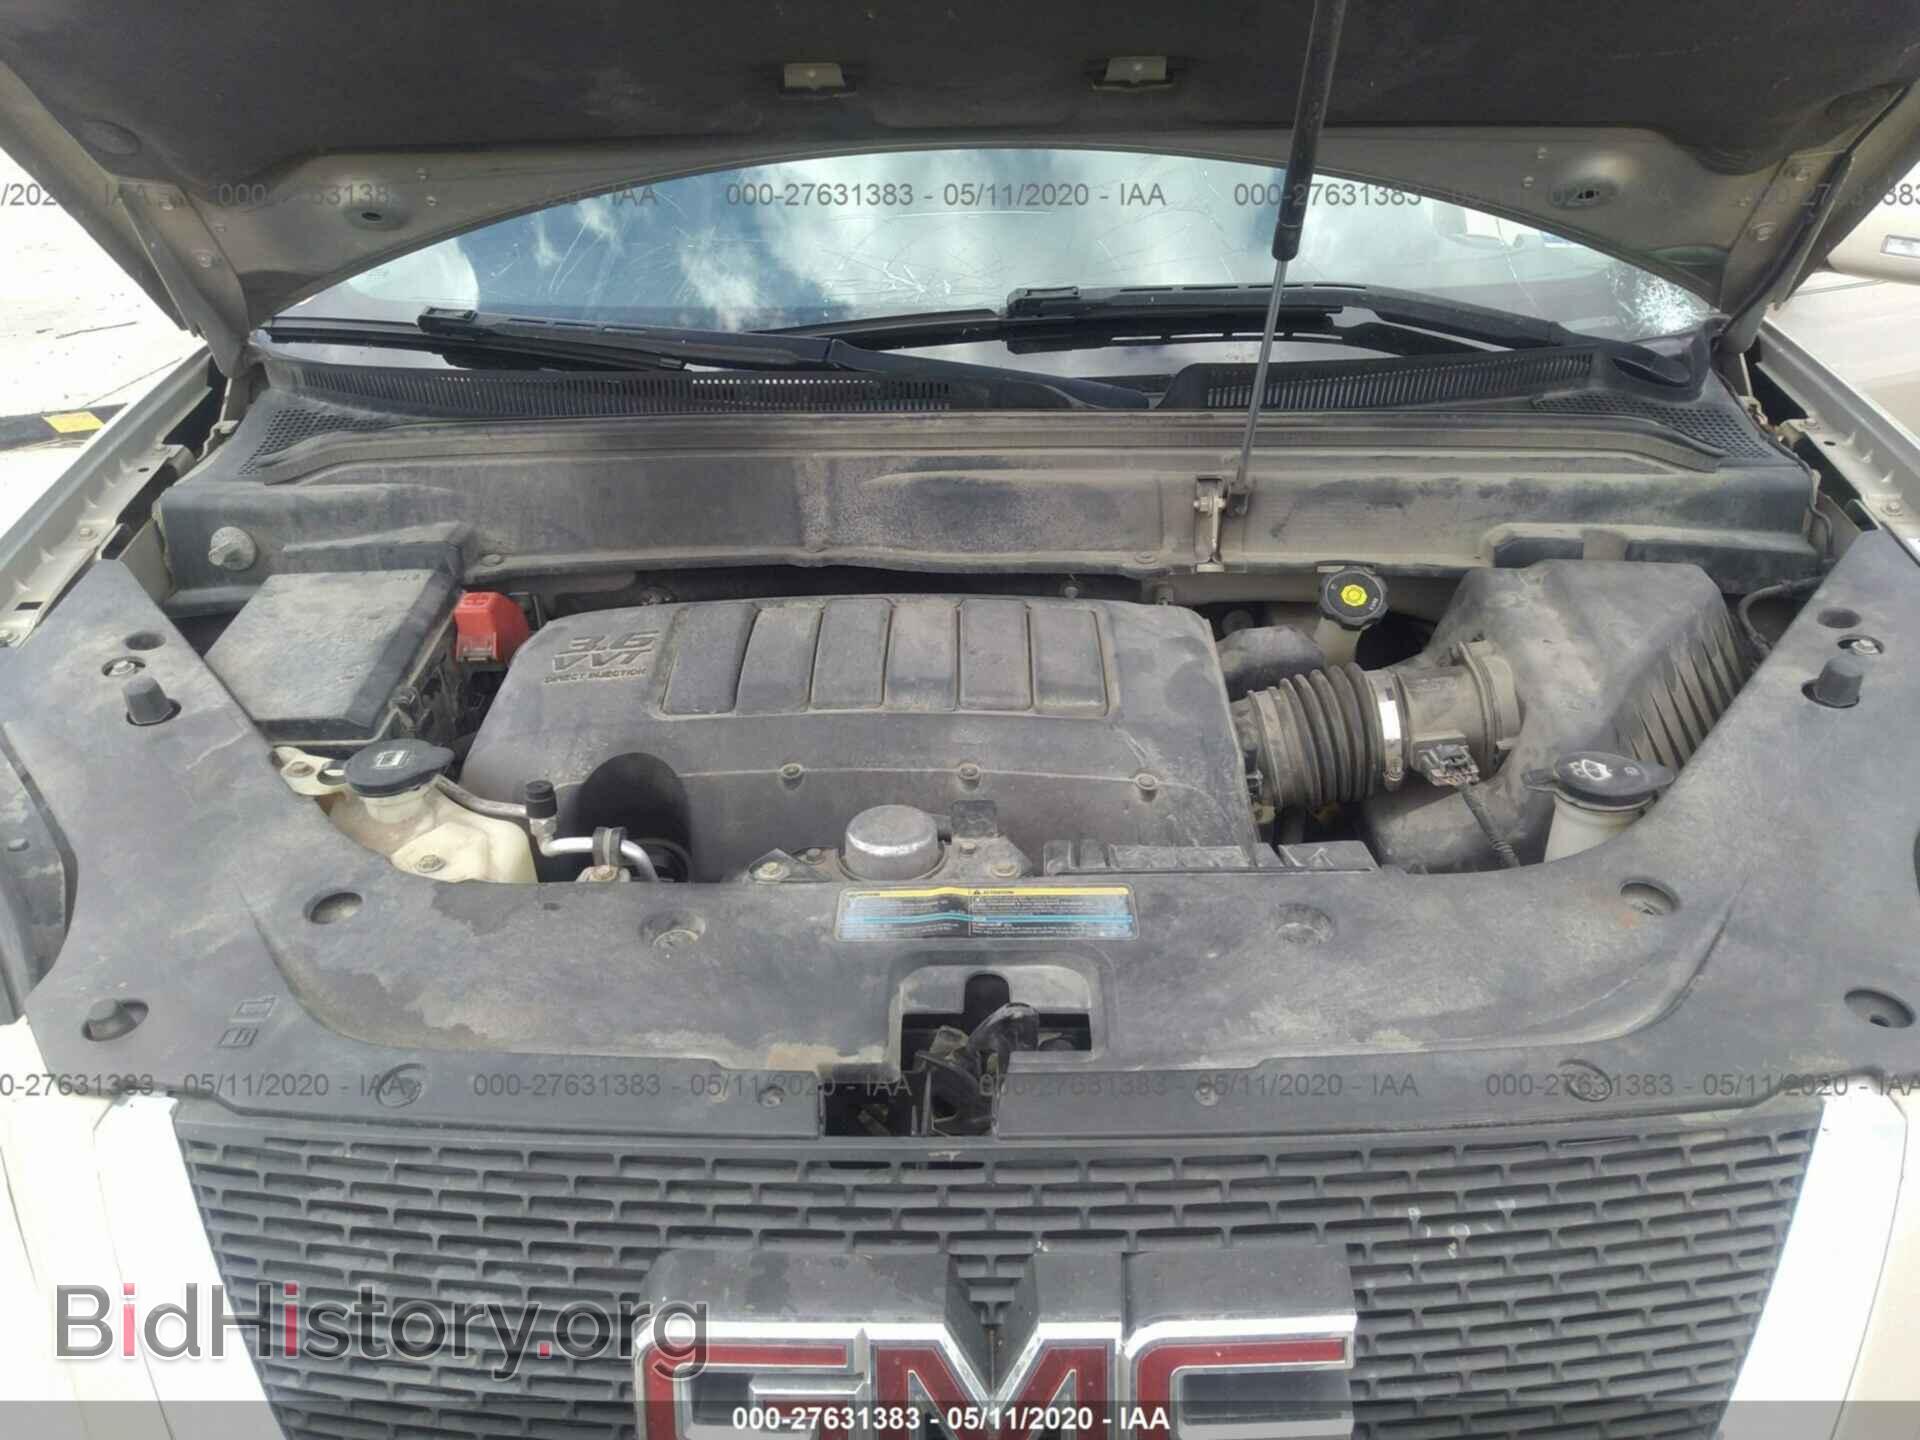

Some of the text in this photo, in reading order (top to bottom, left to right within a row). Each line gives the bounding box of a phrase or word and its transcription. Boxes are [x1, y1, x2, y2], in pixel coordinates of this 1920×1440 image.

[551, 648, 654, 673] VVT
[542, 671, 584, 685] DIRECT
[633, 1316, 1358, 1440] GMC
